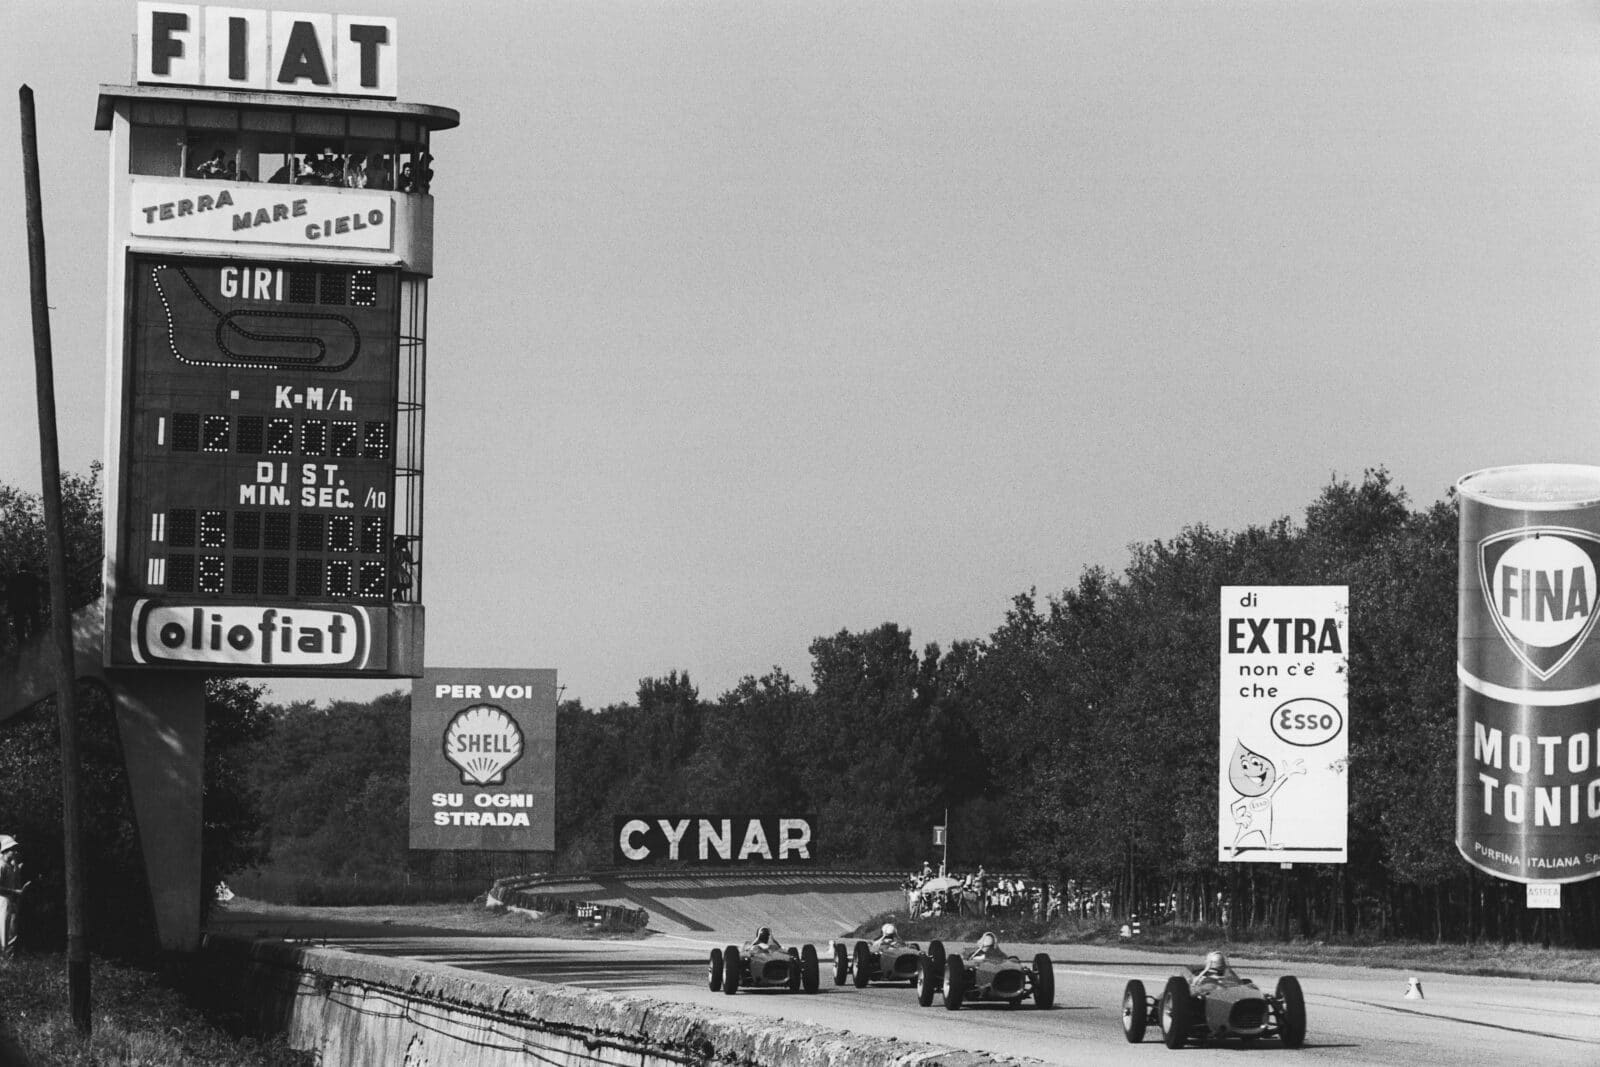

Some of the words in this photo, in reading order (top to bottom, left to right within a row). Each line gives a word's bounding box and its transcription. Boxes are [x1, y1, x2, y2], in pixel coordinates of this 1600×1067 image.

[151, 11, 388, 88] FIAT
[142, 190, 234, 224] TERRA
[232, 199, 308, 231] MARE
[305, 209, 384, 240] CIELO
[220, 266, 283, 301] GIRI
[351, 269, 376, 306] 6
[239, 484, 290, 506] MIN.
[301, 487, 354, 508] SEC.
[199, 556, 224, 592] 8
[1240, 592, 1258, 608] di
[1502, 564, 1589, 622] FINA
[160, 607, 347, 664] oliofiat
[1228, 618, 1342, 654] EXTRA
[1239, 665, 1278, 676] non
[436, 685, 480, 698] PER
[489, 685, 532, 699] VOI
[1239, 683, 1278, 698] che
[457, 734, 511, 753] SHELL
[1474, 721, 1600, 775] MOTO
[432, 793, 463, 807] SU
[474, 793, 533, 807] OGNI
[434, 811, 530, 826] STRADA
[619, 818, 812, 861] CYNAR
[1475, 841, 1521, 866] PURFINA
[1527, 856, 1581, 869] ITALIANA
